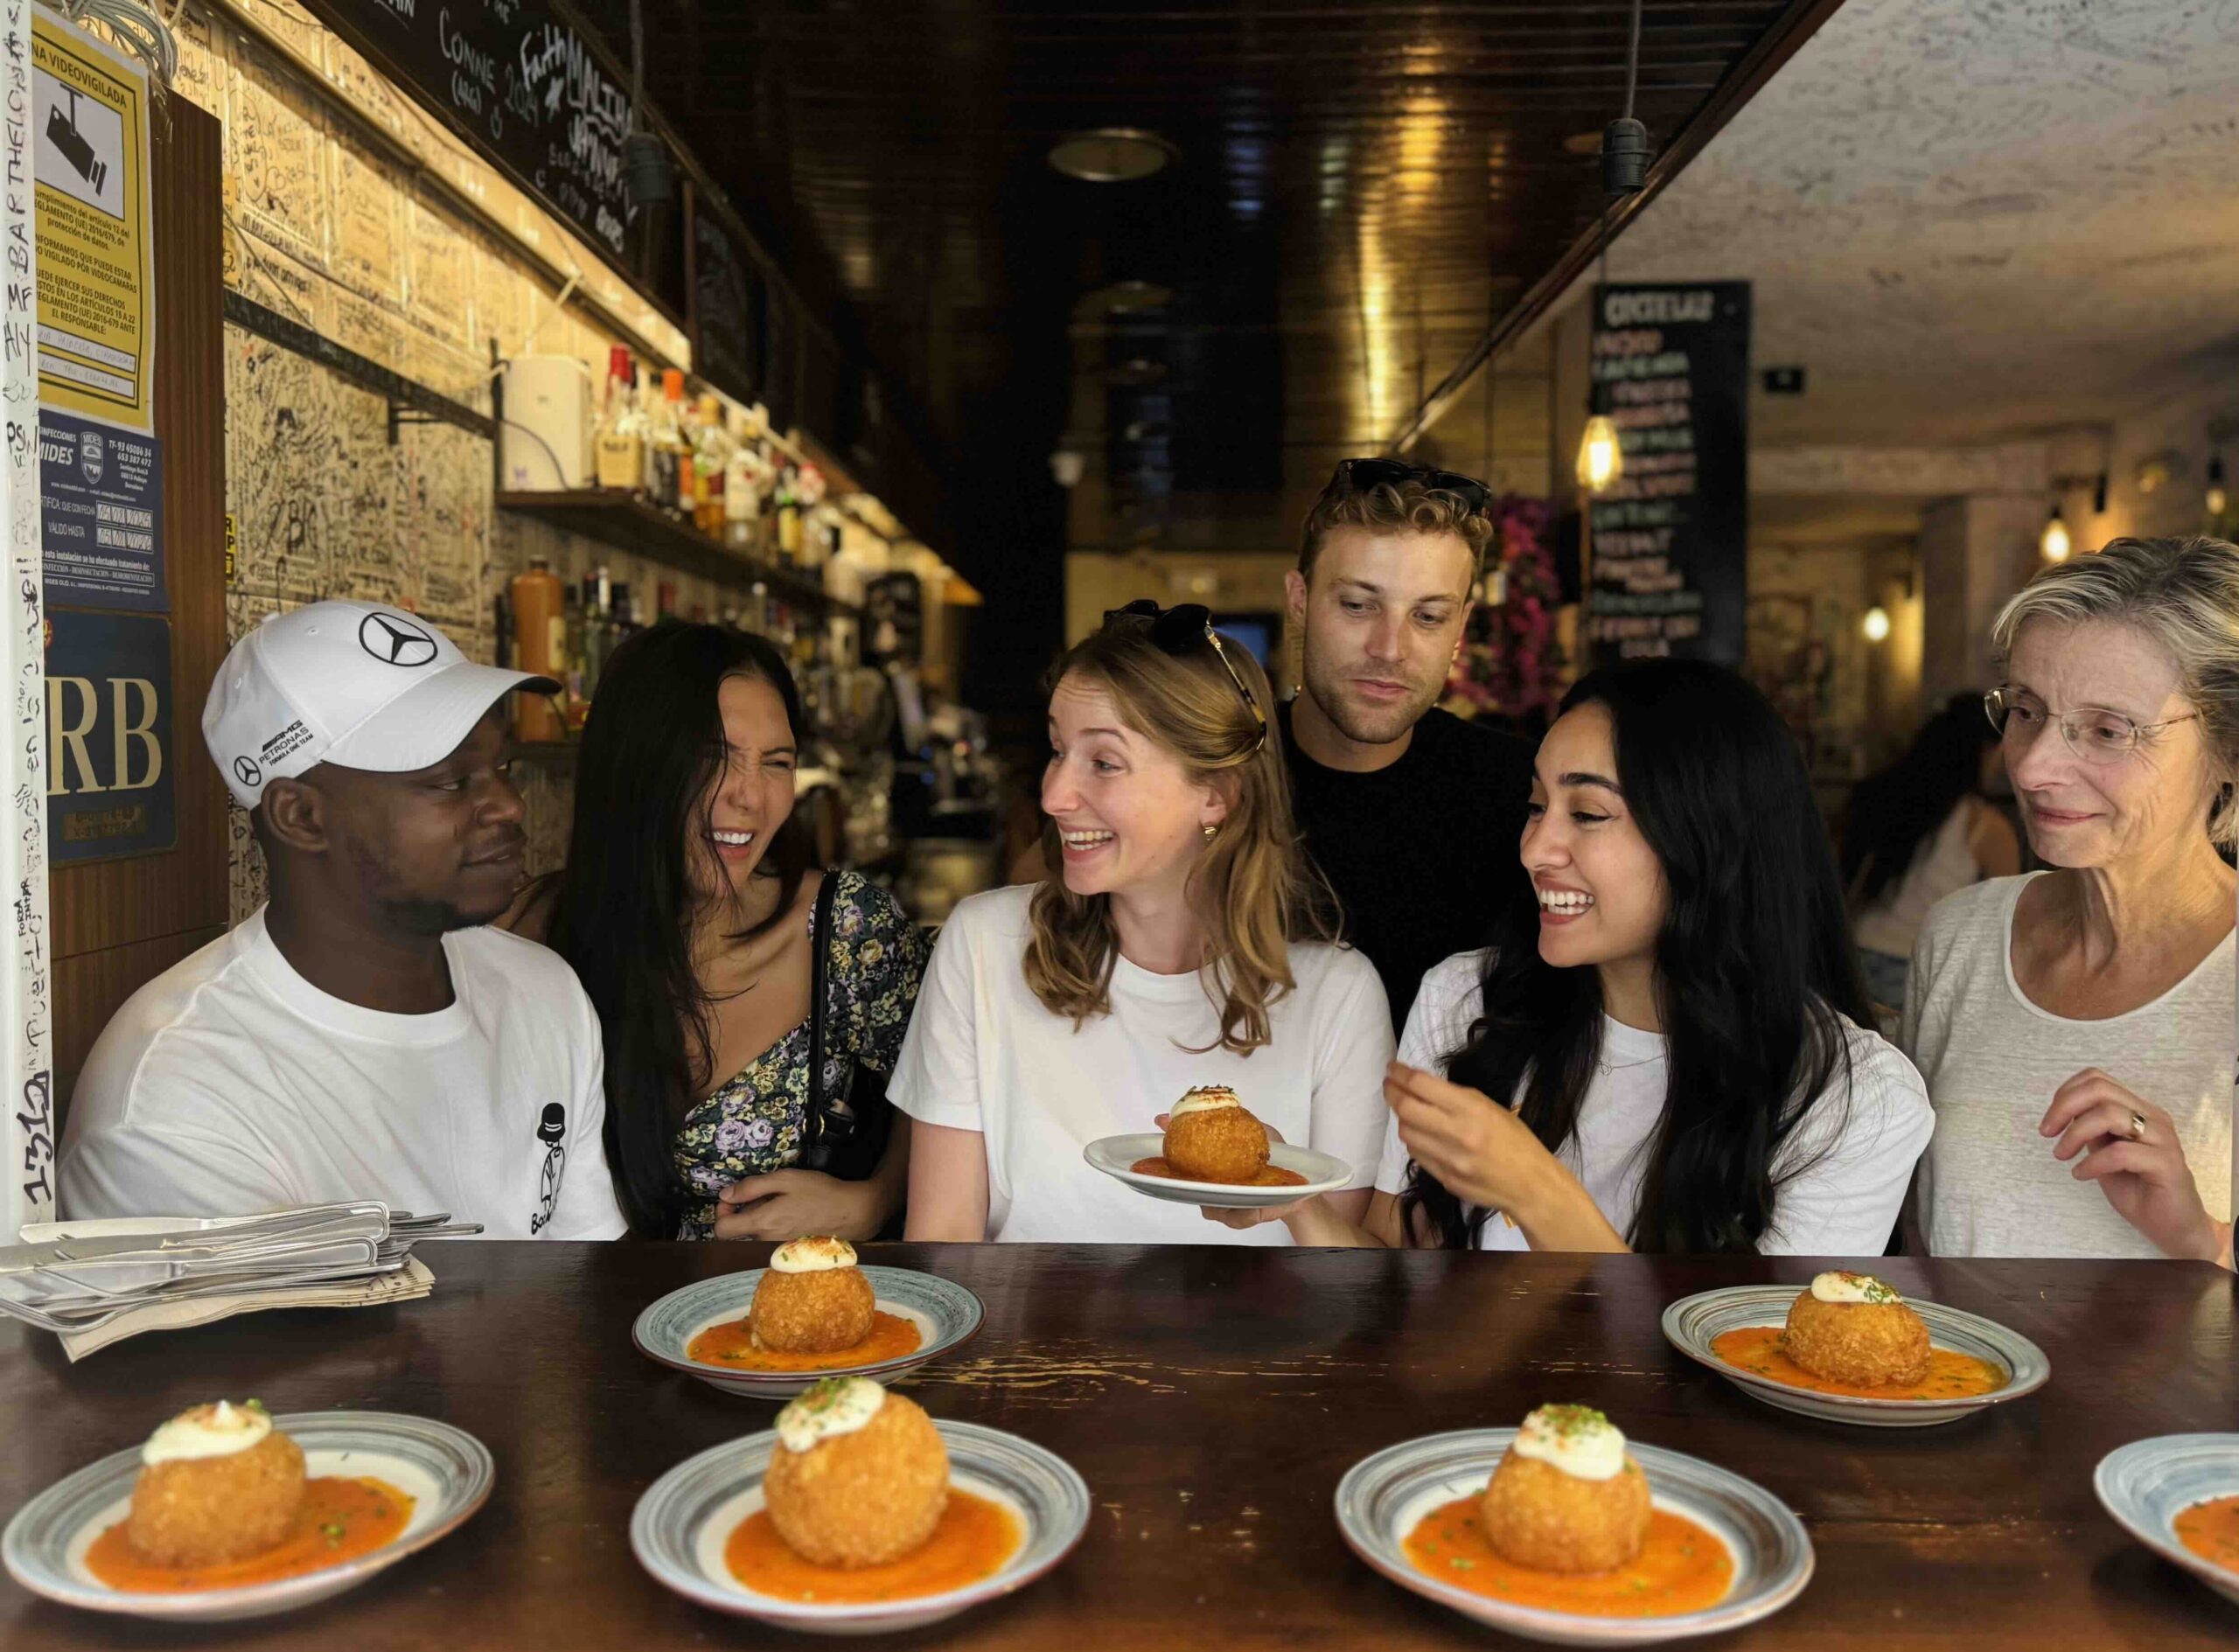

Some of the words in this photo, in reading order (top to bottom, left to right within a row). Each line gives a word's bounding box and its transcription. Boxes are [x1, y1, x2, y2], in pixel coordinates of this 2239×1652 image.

[51, 49, 127, 108] VIDEOVIGILADA
[75, 218, 87, 232] (UE)
[78, 207, 87, 219] del
[47, 217, 82, 239] protección
[83, 233, 90, 241] de
[91, 236, 110, 251] datos.
[44, 247, 76, 268] VIGILADO
[77, 260, 90, 274] POR
[80, 251, 93, 265] QUE
[94, 254, 114, 273] PUEDE
[114, 264, 132, 281] ESTAR
[54, 274, 80, 291] EJERCER
[80, 284, 94, 297] SUS
[94, 290, 125, 310] DERECHOS
[56, 286, 66, 296] EN
[66, 291, 80, 303] LOS
[128, 314, 136, 324] 22
[52, 308, 60, 319] EL
[60, 312, 106, 335] RESPONSABLE:
[79, 306, 93, 320] (UE)
[120, 323, 136, 335] ANTE
[82, 433, 101, 447] MIDES
[117, 441, 125, 452] 93
[144, 448, 152, 458] 34
[116, 451, 129, 463] 653
[140, 457, 152, 468] 472
[273, 719, 303, 743] AMG
[299, 733, 314, 745] TEAM
[259, 727, 310, 764] PETRONAS
[16, 1069, 53, 1206] 1312
